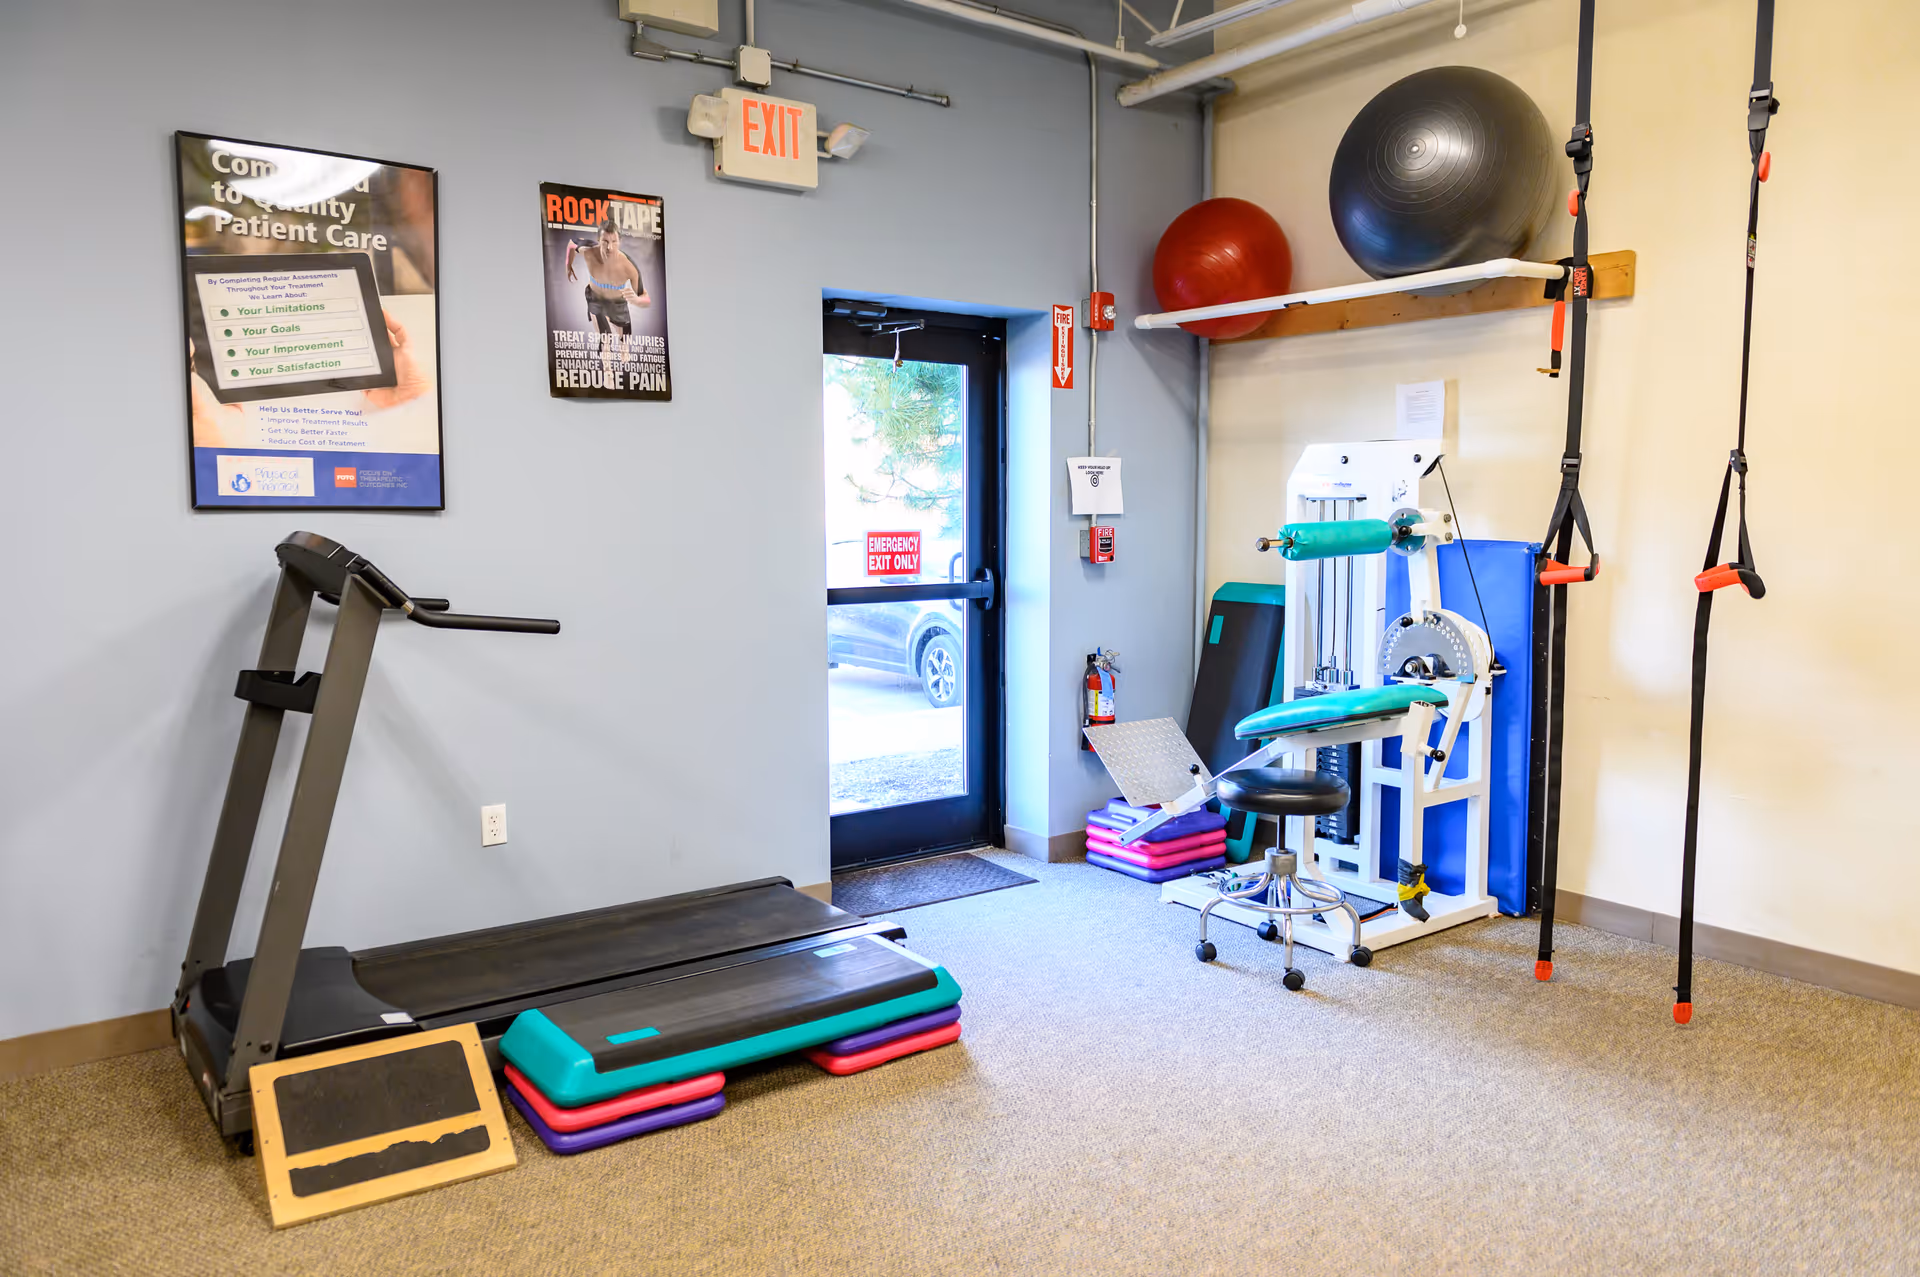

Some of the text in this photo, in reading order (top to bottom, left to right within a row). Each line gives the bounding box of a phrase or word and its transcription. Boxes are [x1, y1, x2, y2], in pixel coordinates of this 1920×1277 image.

[742, 98, 803, 160] EXIT
[211, 181, 243, 205] to
[546, 193, 662, 234] ROCKTAPE
[214, 210, 387, 251] Patient Care
[219, 276, 261, 285] Completing
[292, 272, 338, 280] Assessments
[226, 285, 269, 293] Throughout
[288, 281, 324, 289] Treatment
[237, 303, 326, 316] Your Limitations
[1056, 312, 1070, 325] FIRE
[242, 323, 301, 336] Your Goals
[552, 330, 585, 342] TREAT
[622, 334, 665, 348] INJURIES
[245, 339, 344, 357] Your Improvement
[554, 341, 586, 350] SUPPORT
[587, 343, 600, 351] FOR
[631, 345, 644, 354] AND
[645, 347, 665, 355] JOINTS
[555, 350, 588, 359] PREVENT
[589, 351, 621, 361] INJURIES
[639, 354, 666, 364] FATIGUE
[249, 360, 341, 376] Your Satisfaction
[555, 359, 666, 374] ENHANCE PERFORMANCE
[556, 369, 666, 391] REDUCE PAIN
[259, 406, 278, 414] Help
[293, 407, 319, 415] Better
[344, 409, 363, 417] You!
[267, 417, 369, 427] Improve Treatment Results
[300, 428, 324, 436] Better
[268, 437, 297, 445] Reduce
[327, 439, 366, 447] Treatment
[1098, 528, 1113, 538] FIRE
[869, 536, 919, 552] EMERGENCY
[869, 554, 919, 570] EXIT ONLY
